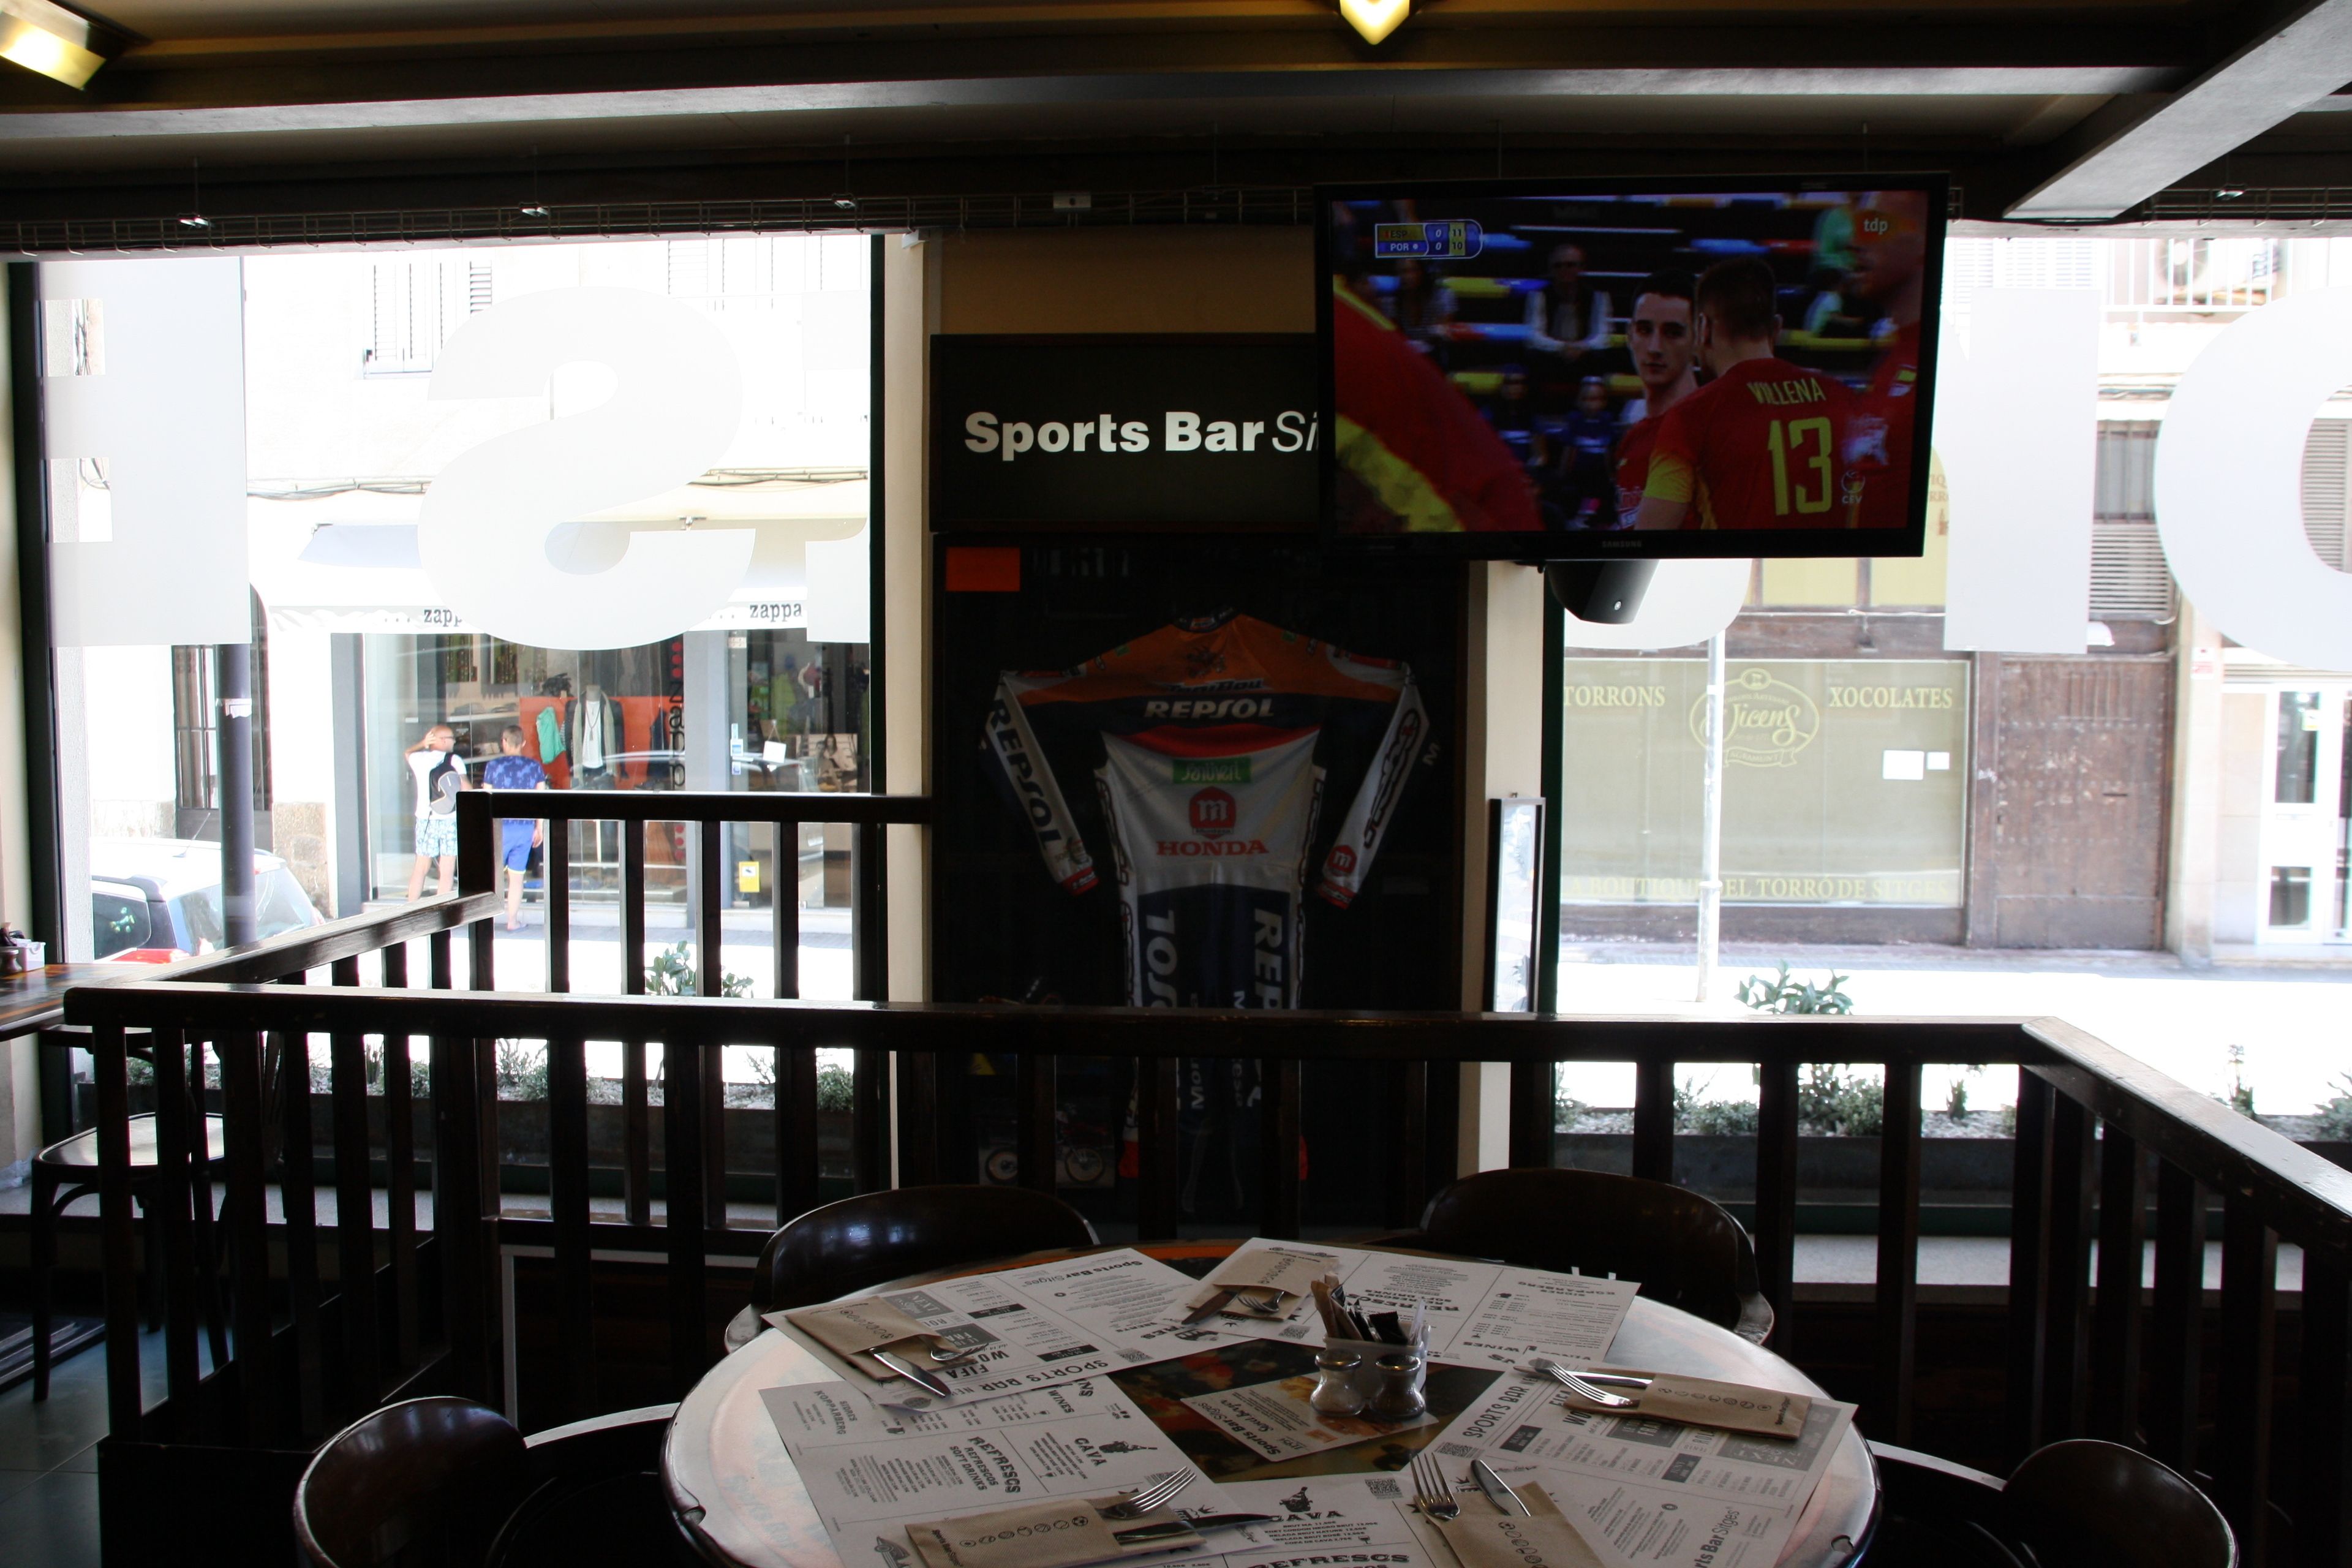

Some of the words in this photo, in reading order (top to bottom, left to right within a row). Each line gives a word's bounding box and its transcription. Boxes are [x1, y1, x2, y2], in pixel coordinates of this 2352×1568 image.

[1435, 228, 1442, 237] 0
[1863, 216, 1888, 236] tdp
[1746, 377, 1827, 406] VILLENA
[965, 411, 1150, 461] Sports
[1165, 411, 1264, 452] Bar
[1272, 410, 1318, 452] Si
[1766, 416, 1833, 516] 13
[1841, 494, 1863, 504] CEV
[1601, 540, 1642, 548] SAMSUNG
[749, 601, 803, 623] zappa
[1564, 685, 1665, 707] TORRONS
[1830, 687, 1953, 709] XOCOLATES
[1143, 698, 1275, 719] REPSOL
[989, 699, 1062, 850] REPSOL
[1156, 840, 1269, 856] HONDA
[1720, 878, 1752, 899] EL
[1757, 873, 1834, 899] TORRÓ
[1837, 880, 1867, 899] DE
[1871, 878, 1949, 900] SITGES
[1066, 1270, 1093, 1278] Bar
[1095, 1261, 1143, 1273] Sports
[1462, 1341, 1520, 1353] WINES
[946, 1364, 989, 1378] FIFA
[1026, 1360, 1109, 1382] SPORTS
[979, 1378, 1023, 1391] BAR
[1048, 1390, 1075, 1414] WINES
[1548, 1390, 1572, 1407] FIFA
[814, 1390, 846, 1435] KOPPARBERG
[840, 1401, 858, 1422] SIDRES
[1462, 1403, 1511, 1438] SPORTS
[1498, 1385, 1530, 1403] BAR
[1224, 1418, 1246, 1432] Bar
[1074, 1438, 1107, 1466] CAVA
[1243, 1429, 1281, 1455] Sports
[950, 1446, 967, 1464] SOFT
[962, 1461, 988, 1491] DRINKS
[964, 1447, 999, 1486] REFRESCOS
[968, 1436, 1021, 1493] REFRESCS
[1268, 1510, 1346, 1522] CAVA
[1700, 1532, 1725, 1553] Bar
[1716, 1509, 1740, 1536] Sitges
